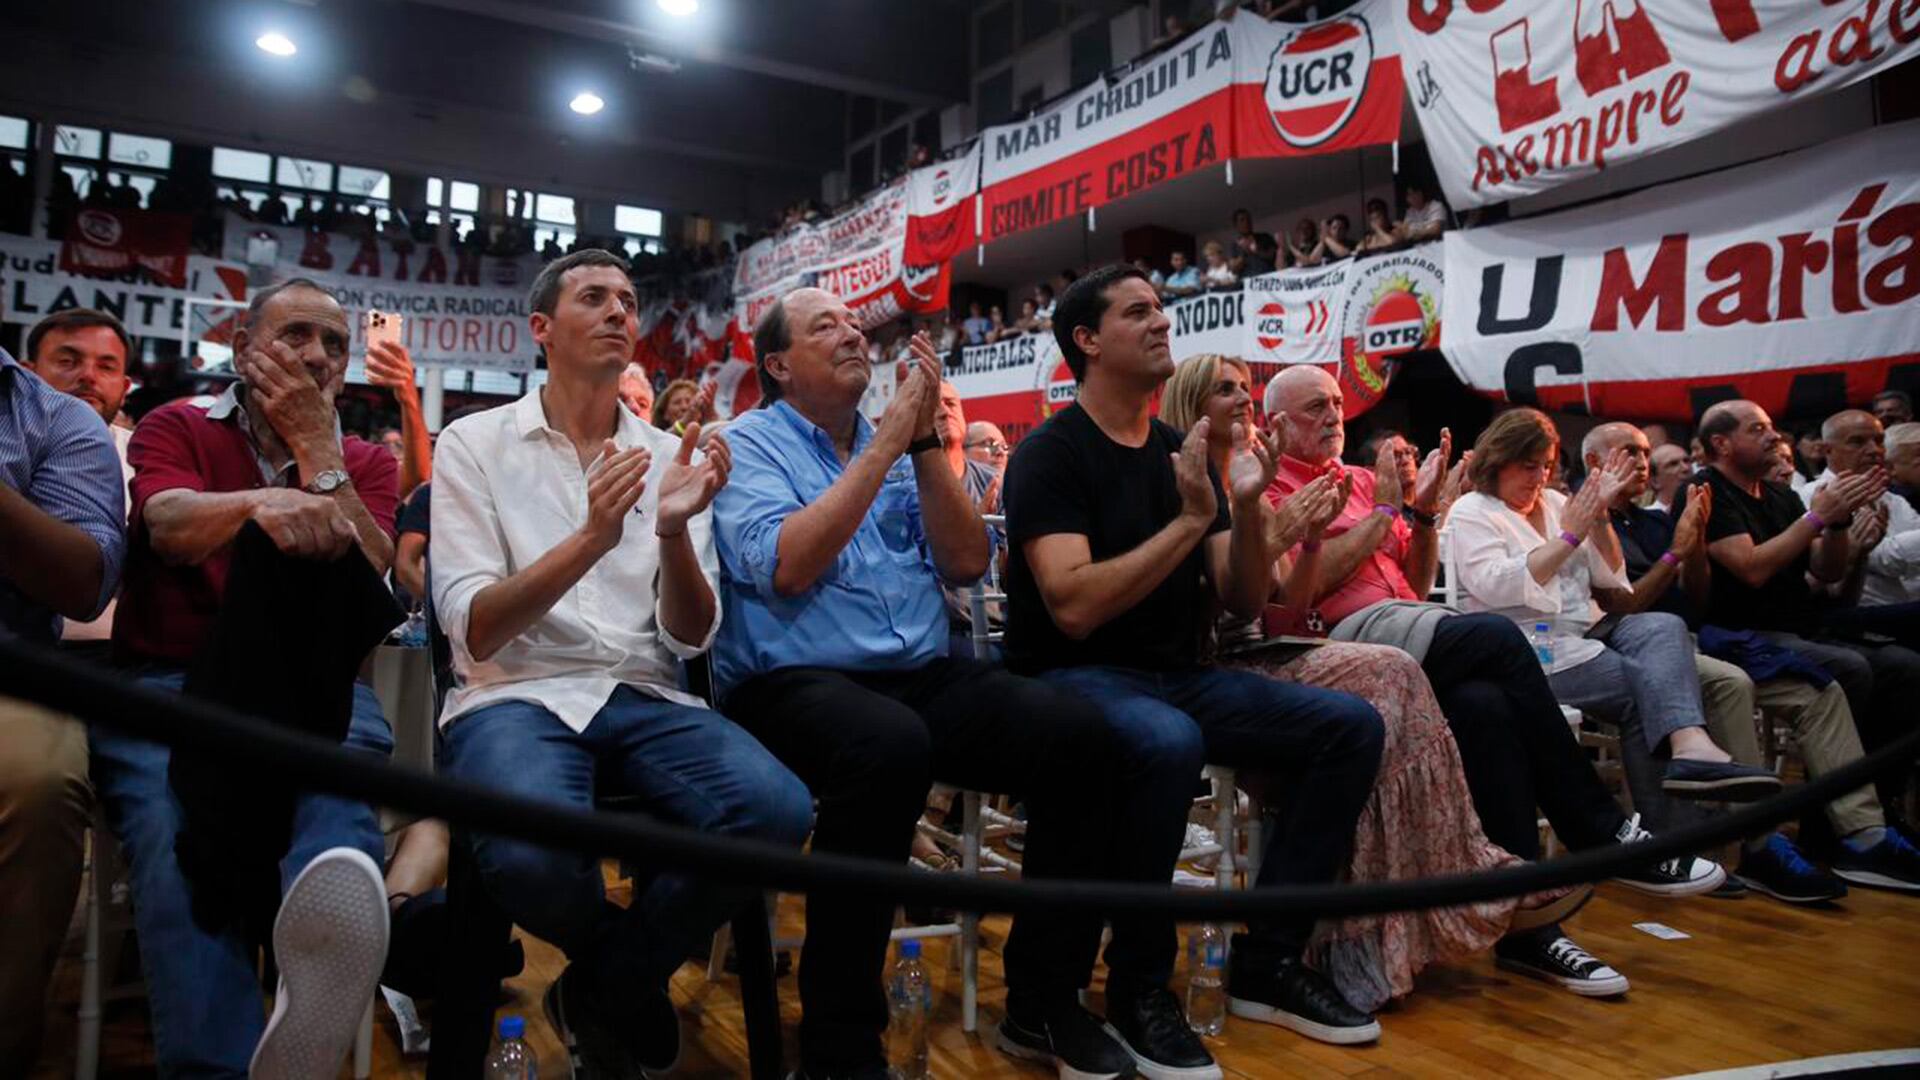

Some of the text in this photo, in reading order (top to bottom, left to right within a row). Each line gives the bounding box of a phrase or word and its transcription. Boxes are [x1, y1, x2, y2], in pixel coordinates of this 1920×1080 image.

[1279, 50, 1354, 99] UCR
[996, 119, 1060, 161] MAR
[990, 123, 1217, 238] COMITE COSTA
[1590, 183, 1920, 332] María
[0, 277, 184, 329] LANTE
[444, 296, 529, 318] RADICAL
[1369, 327, 1420, 348] OTR
